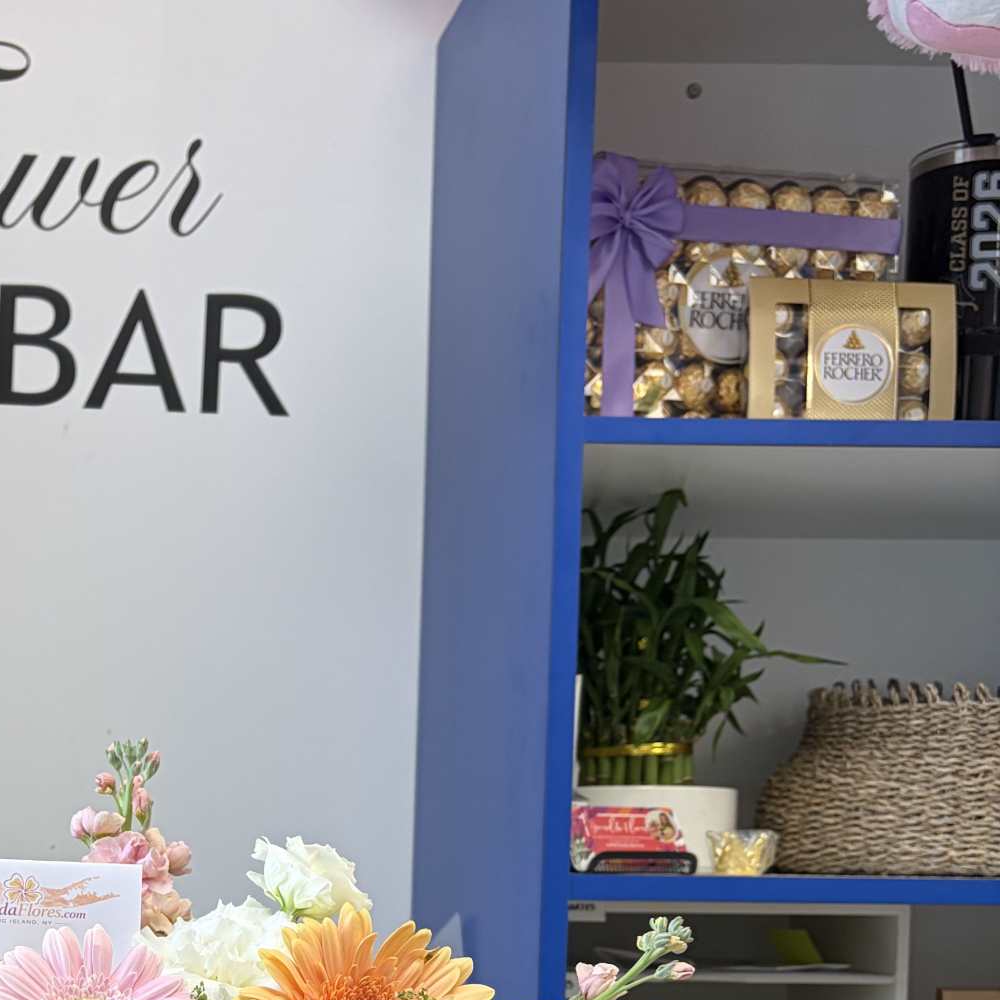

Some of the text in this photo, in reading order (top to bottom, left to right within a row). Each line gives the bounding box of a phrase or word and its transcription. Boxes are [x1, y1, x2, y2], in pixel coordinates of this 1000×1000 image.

[950, 175, 970, 272] CLASS OF
[969, 170, 1000, 291] 2026
[822, 366, 883, 381] ROCHER
[823, 352, 884, 367] FERRERO
